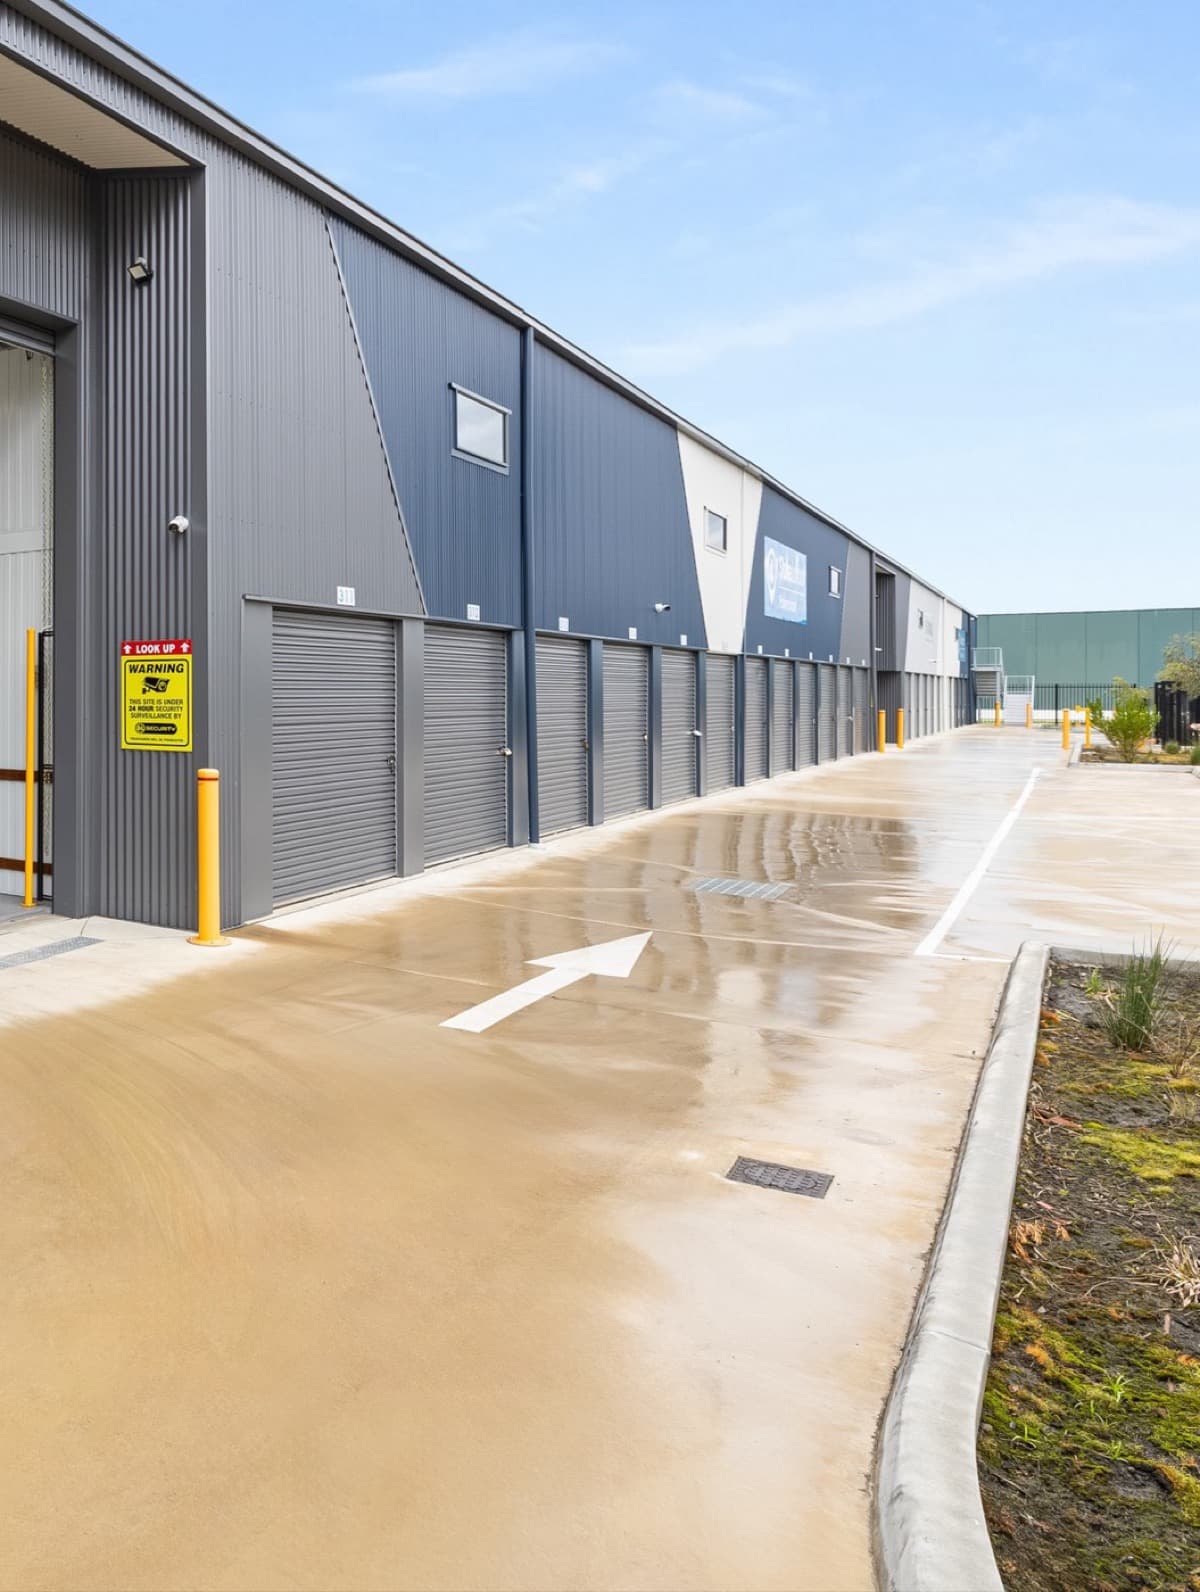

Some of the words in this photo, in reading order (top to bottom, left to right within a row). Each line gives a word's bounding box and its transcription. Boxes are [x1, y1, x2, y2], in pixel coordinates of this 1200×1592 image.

[135, 645, 160, 654] LOOK
[163, 644, 176, 653] UP
[129, 664, 184, 673] WARNING
